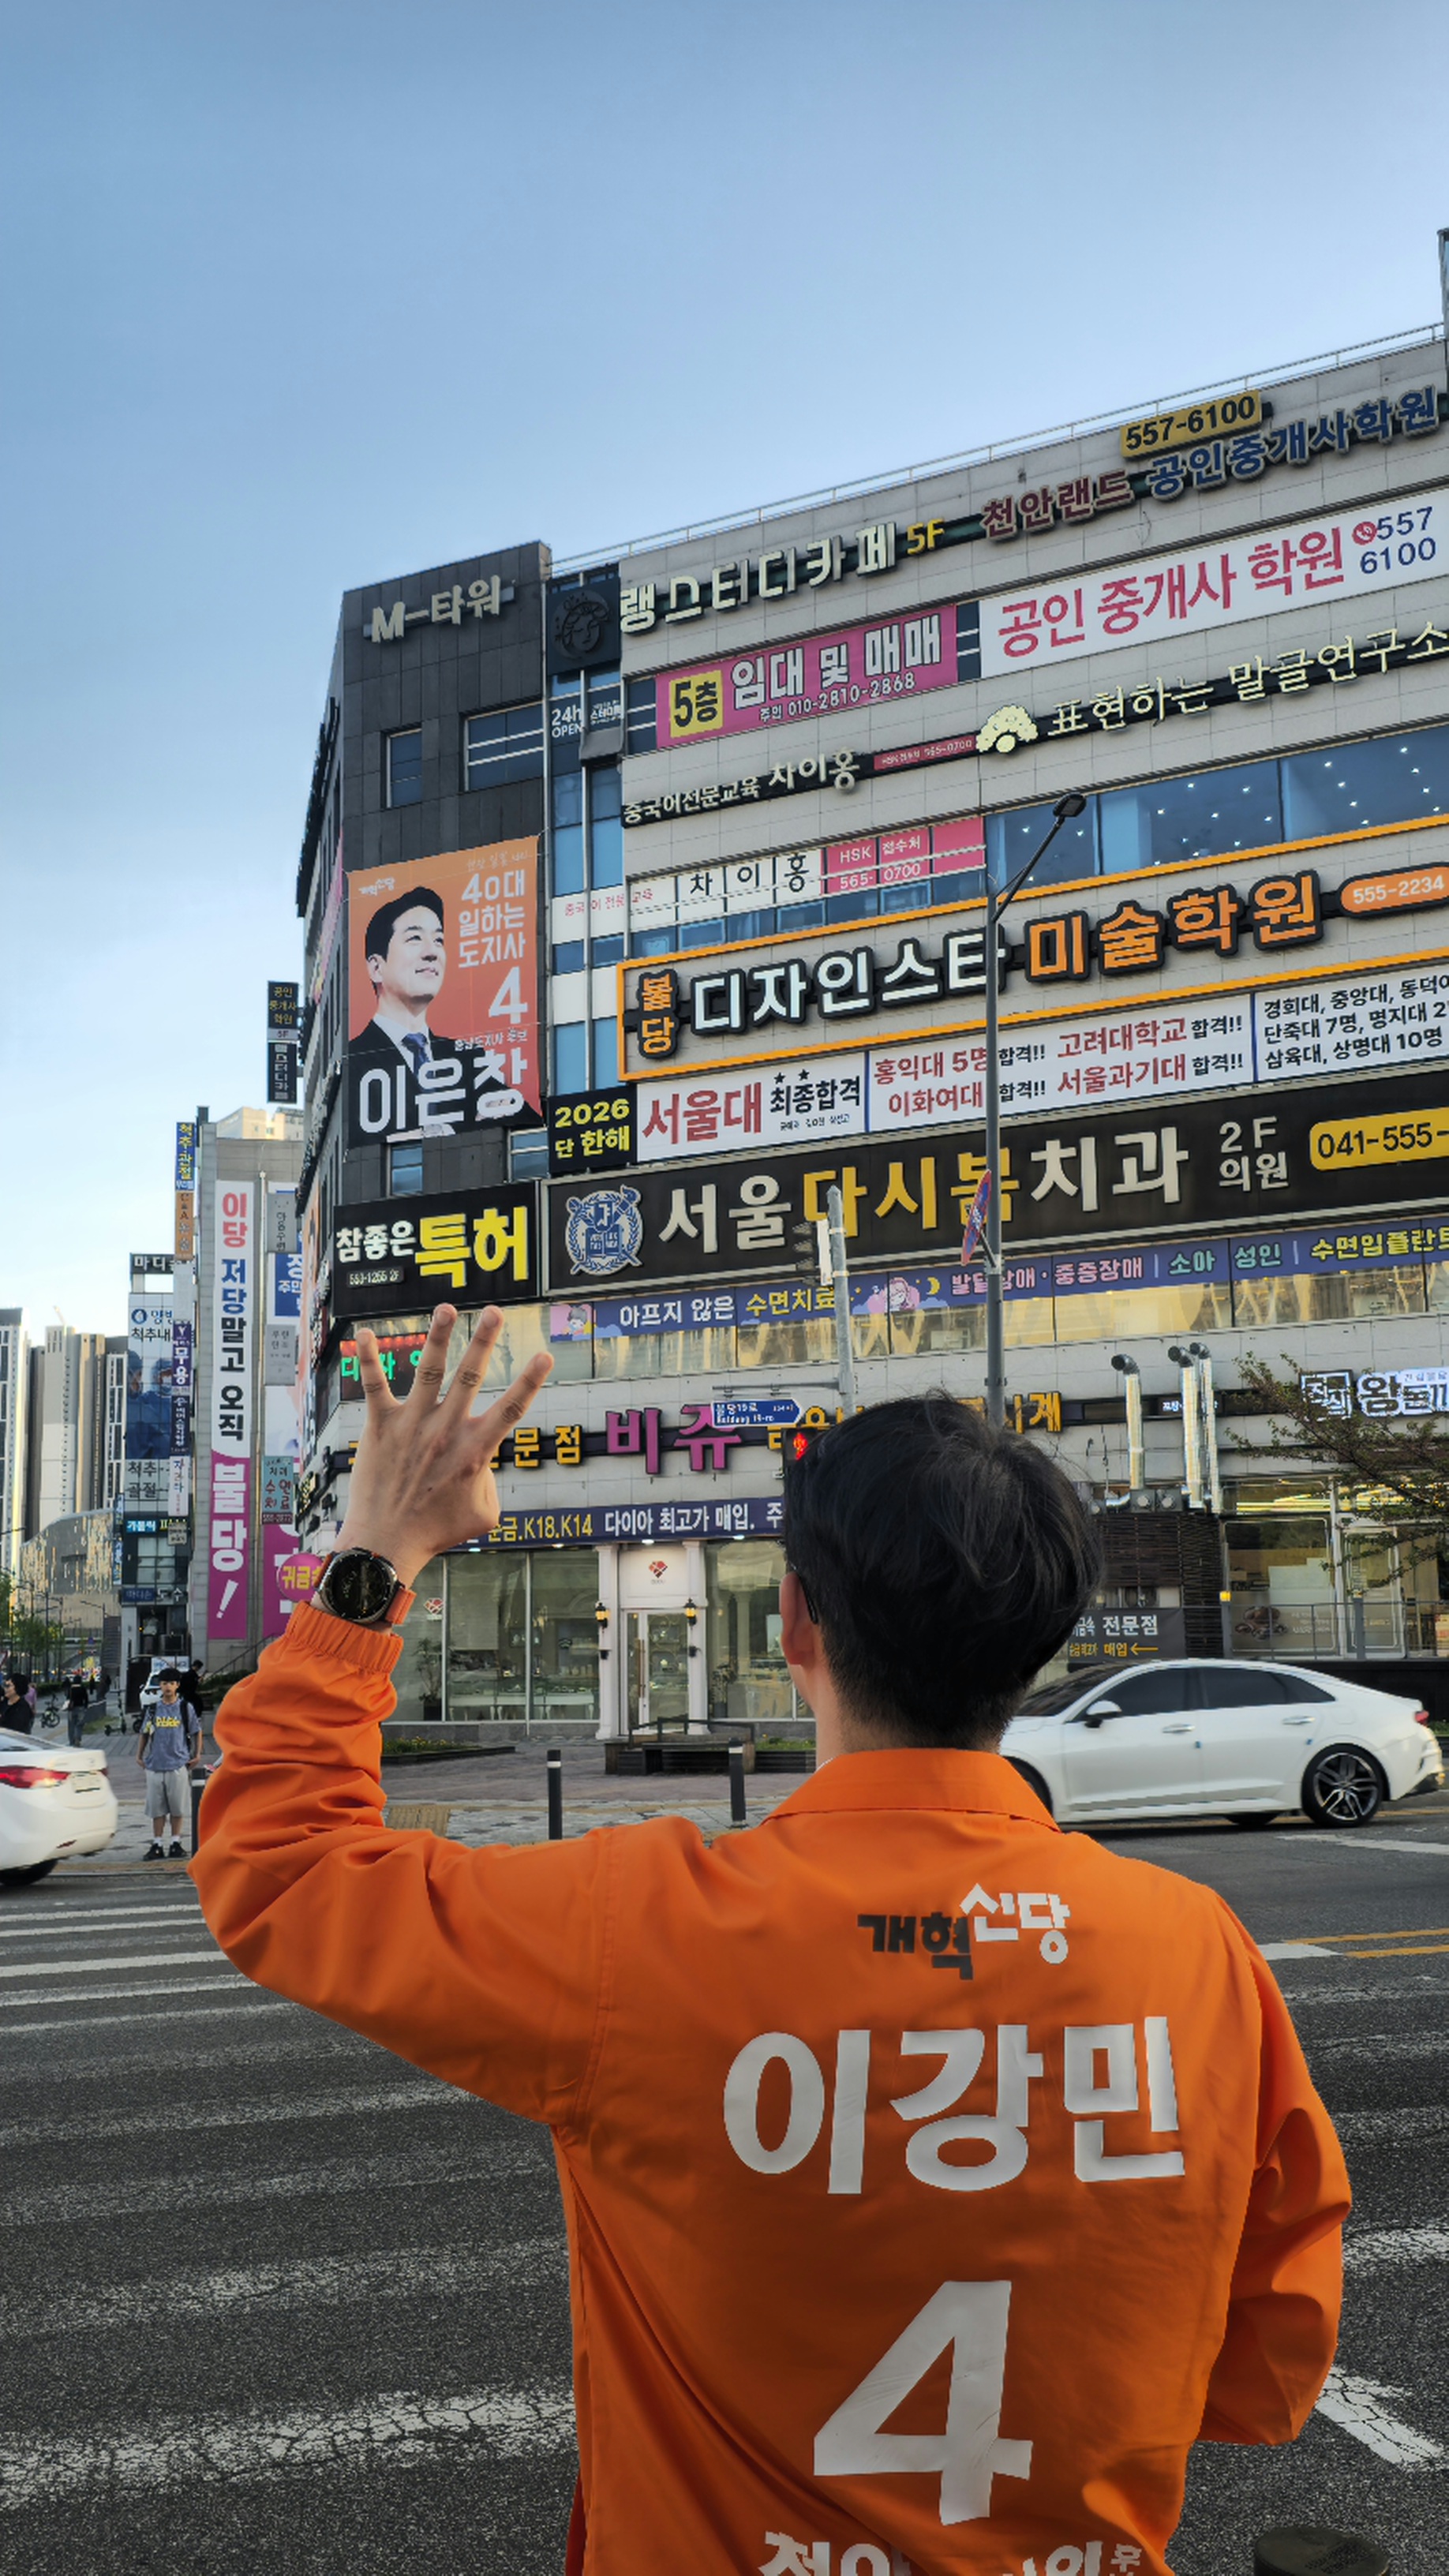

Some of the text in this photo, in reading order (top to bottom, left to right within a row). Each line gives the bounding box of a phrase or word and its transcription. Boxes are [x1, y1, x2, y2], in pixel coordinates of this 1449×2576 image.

[1125, 394, 1256, 451] 557-6100
[620, 385, 1438, 633] 랭스터디카페 5F 천안랜드 공인중개사학원
[1376, 506, 1434, 541] 557
[1360, 537, 1437, 575] 6100
[998, 525, 1345, 658] 공인 중개사 학원
[673, 680, 719, 728] 5층
[731, 646, 805, 710] 임대
[819, 642, 849, 691] 및
[864, 613, 942, 678] 매매
[1048, 621, 1449, 738] 표현하는 말글연구소
[759, 672, 916, 723] 주인 010-2810-2868
[623, 775, 761, 825] 중국어전문교육
[839, 834, 922, 864] HSK 접수처
[461, 869, 526, 904] 40대
[458, 901, 526, 938] 일하는
[1028, 874, 1316, 978] 미술학원
[1352, 874, 1445, 906] 555-2234
[458, 931, 527, 969] 도지사
[488, 965, 528, 1025] 4
[1330, 983, 1395, 1010] 중앙대,
[1057, 1015, 1242, 1058] 고려대학교 합격!!
[1325, 1012, 1365, 1035] 7명,
[1368, 1002, 1428, 1030] 명지대
[874, 1050, 945, 1086] 홍익대
[998, 1043, 1046, 1067] 합격!!
[1264, 1025, 1443, 1070] 삼육대, 상명대 10명
[358, 1046, 528, 1134] 이은창
[1057, 1053, 1244, 1096] 서울과기대 합격!!
[555, 1098, 631, 1129] 2026
[642, 1075, 860, 1145] 서울대 최종합격
[888, 1080, 1046, 1118] 이화여대 합격!!
[555, 1125, 631, 1159] 단 한해
[1220, 1116, 1278, 1154] 2F
[1219, 1151, 1290, 1193] 의원
[222, 1192, 249, 1249] 이당
[336, 1206, 529, 1289] 참좋은 특허
[619, 1300, 683, 1329] 아프지
[691, 1295, 736, 1323] 않은
[745, 1286, 836, 1317] 수면치료
[1168, 1249, 1216, 1276] 소아
[1234, 1242, 1282, 1270] 성인
[218, 1384, 245, 1441] 오직
[488, 1425, 582, 1469] 문점
[605, 1508, 653, 1537] 다이아
[658, 1505, 710, 1534] 최고가
[715, 1503, 755, 1532] 매입.
[1102, 1615, 1159, 1636] 전문점
[857, 1883, 1071, 1981] 개혁신당
[723, 2016, 1185, 2195] 이강민
[813, 2279, 1034, 2525] 4
